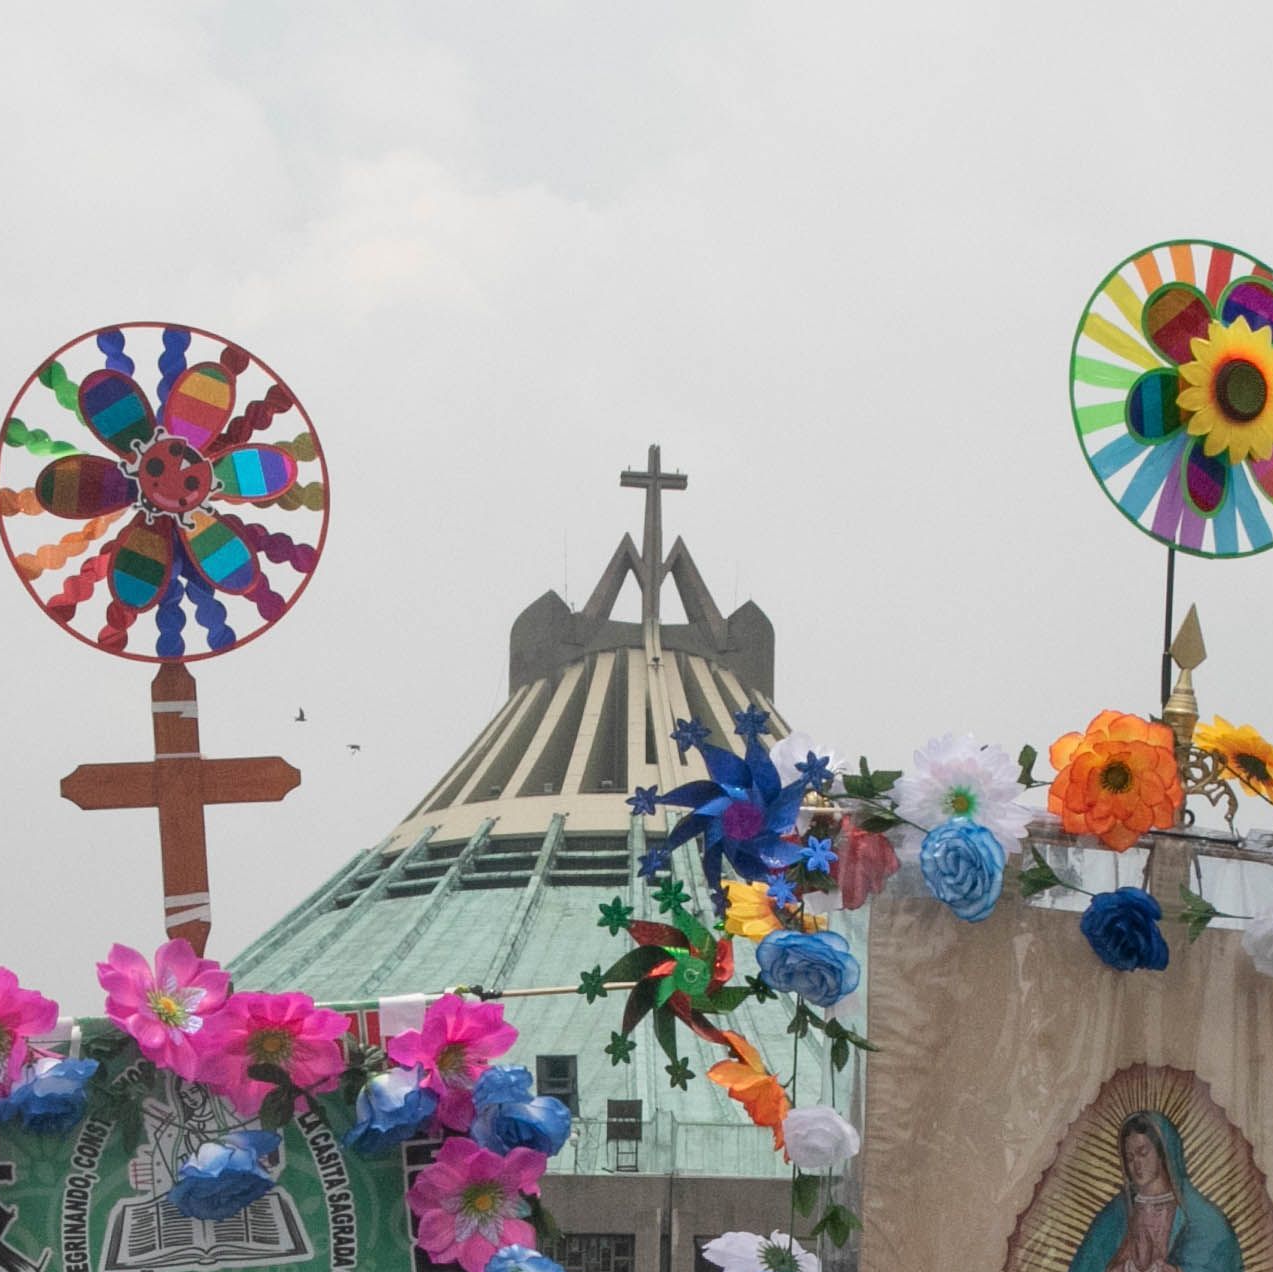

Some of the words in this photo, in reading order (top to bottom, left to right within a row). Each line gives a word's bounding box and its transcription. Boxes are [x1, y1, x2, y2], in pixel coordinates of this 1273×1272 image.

[298, 1112, 320, 1135] LA
[310, 1131, 345, 1190] CASITA
[330, 1190, 354, 1268] SAGRADA
